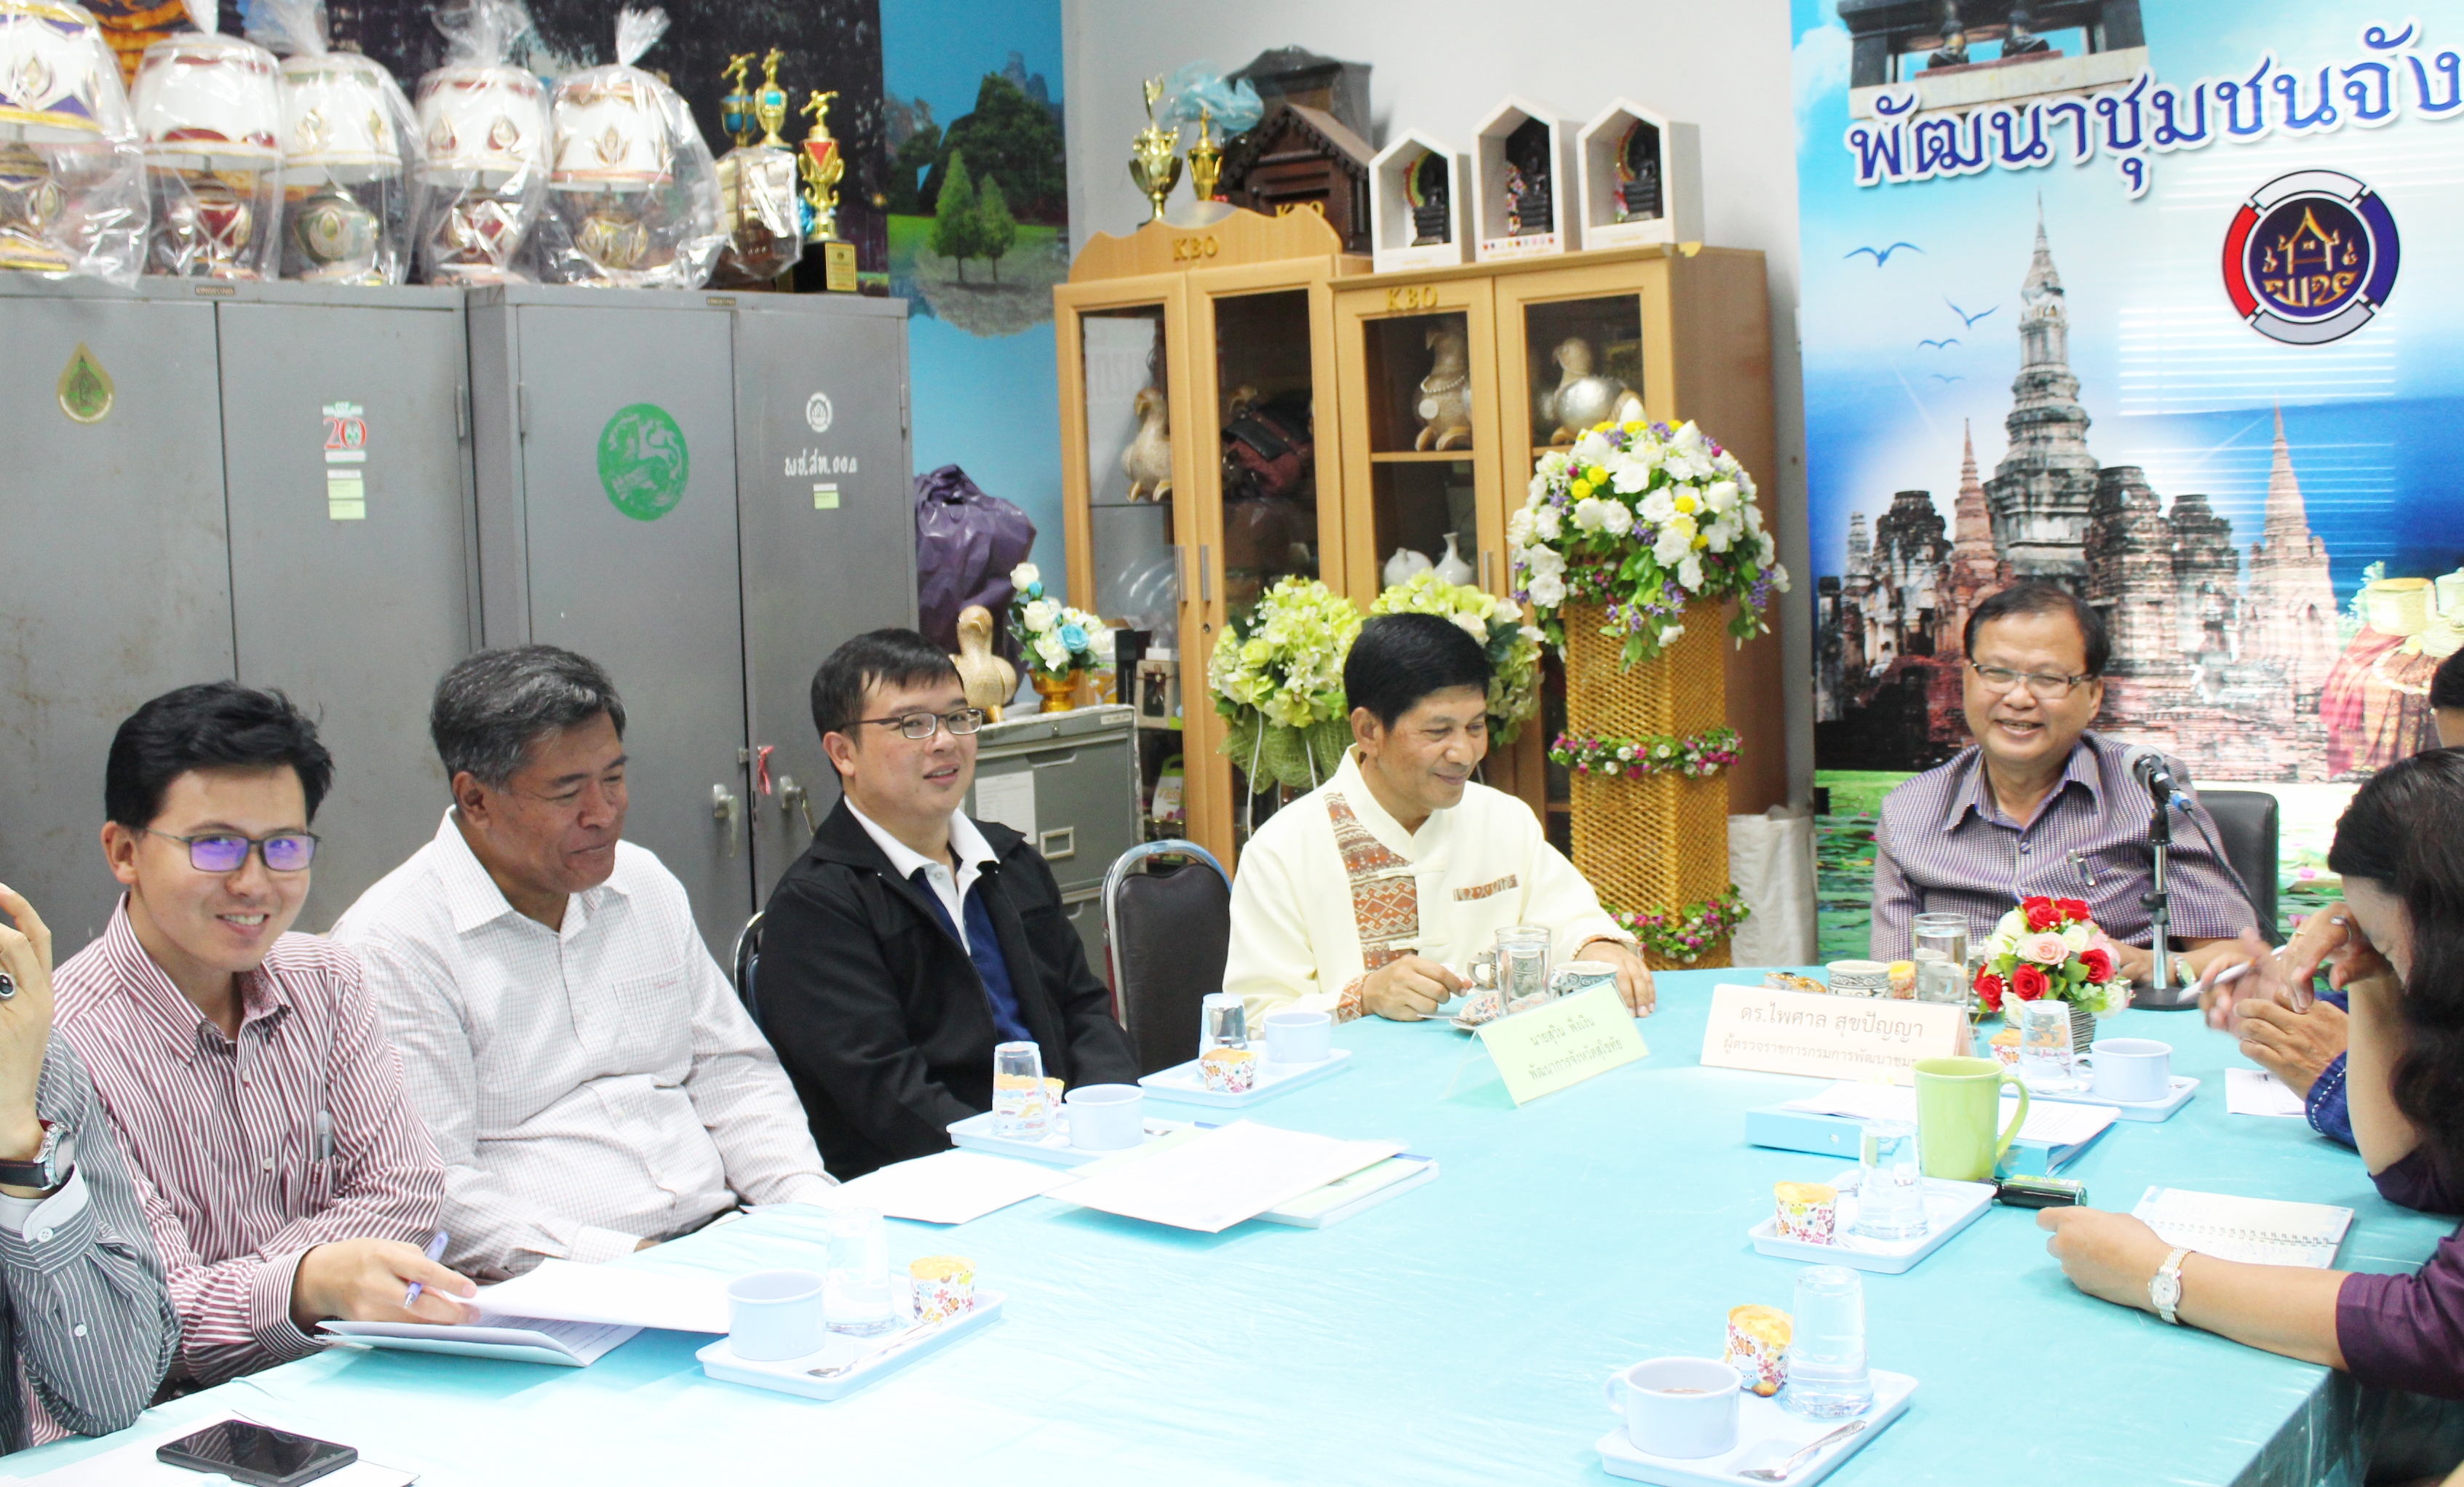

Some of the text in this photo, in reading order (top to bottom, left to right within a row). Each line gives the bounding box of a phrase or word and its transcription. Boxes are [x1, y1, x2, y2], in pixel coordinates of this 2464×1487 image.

[1850, 23, 2464, 191] พัฒนาชุมชนจัง
[1275, 200, 1324, 218] KO
[1172, 234, 1220, 261] KBO
[1386, 286, 1439, 312] KBO
[323, 416, 367, 450] 20
[1741, 1000, 1923, 1043] ดร.ไพศาล สุขปัญญา
[1528, 1035, 1624, 1080] พัฒนาการจังหวัดสุโขทัย
